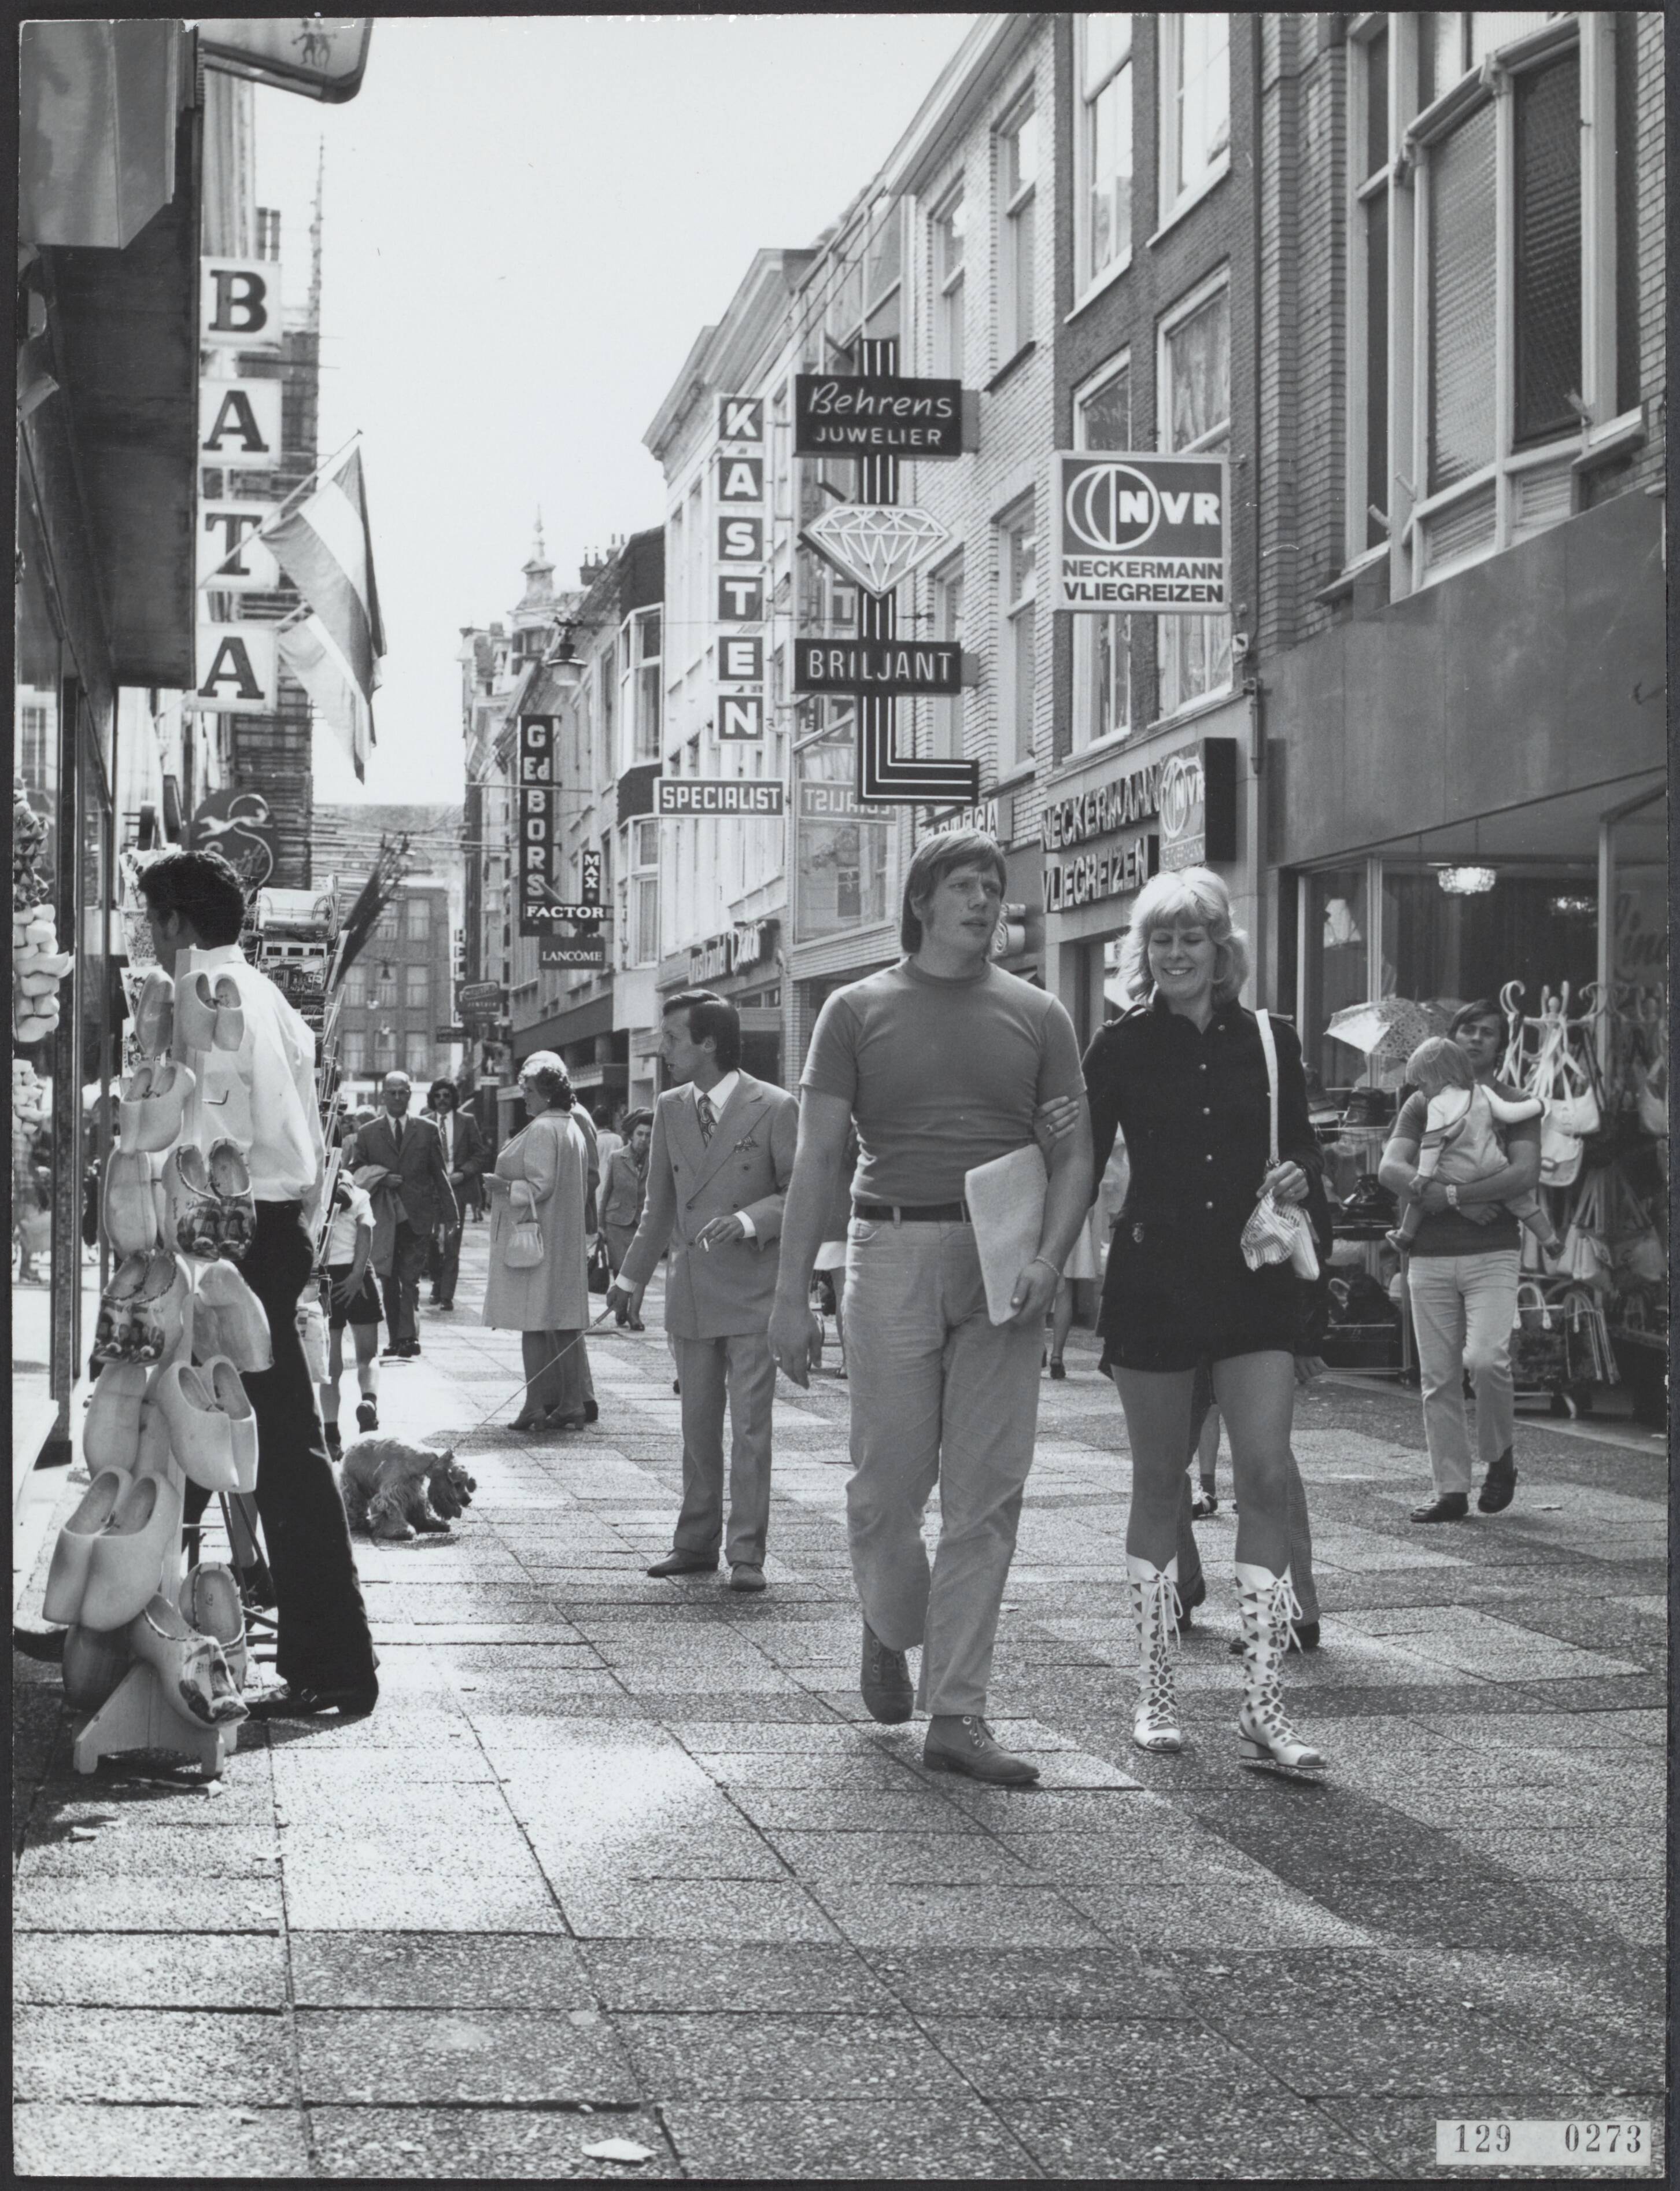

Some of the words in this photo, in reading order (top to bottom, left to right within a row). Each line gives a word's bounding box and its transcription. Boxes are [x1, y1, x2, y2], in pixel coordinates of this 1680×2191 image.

[810, 382, 953, 418] Behrens
[816, 427, 942, 446] JUWELIER
[197, 270, 269, 699] BATA
[1119, 490, 1221, 525] NVR
[723, 401, 758, 734] KASTEN
[1063, 559, 1224, 580] NECKERMANN
[1064, 582, 1224, 603] VLIEGREIZEN
[810, 649, 954, 680] BRILJANT
[662, 787, 781, 810] SPECIALIST
[1042, 765, 1160, 851] NECKERMANN
[584, 854, 600, 888] MAX
[1043, 836, 1149, 914] VLIEGREIZEN
[526, 905, 604, 919] FACTOR
